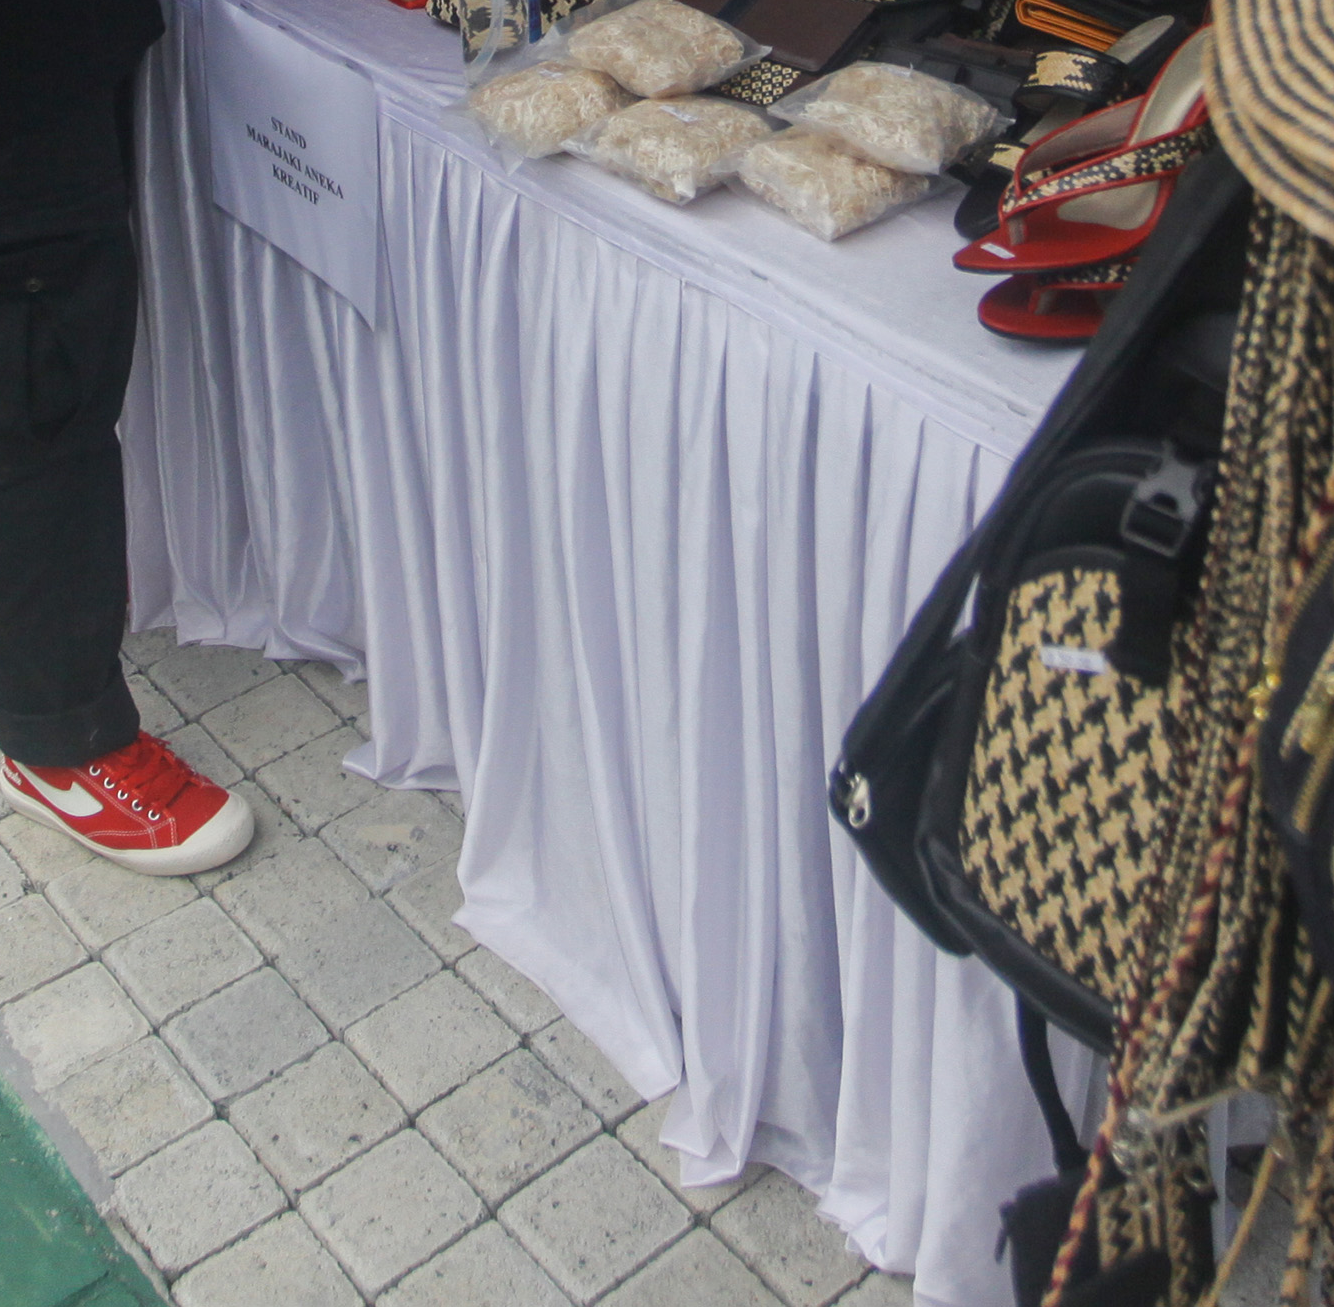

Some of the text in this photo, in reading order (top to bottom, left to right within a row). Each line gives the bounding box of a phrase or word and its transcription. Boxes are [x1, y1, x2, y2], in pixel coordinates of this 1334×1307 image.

[271, 117, 307, 149] STAND
[247, 125, 344, 199] MARAJAKI ANEKA
[273, 165, 320, 205] KREATIF
